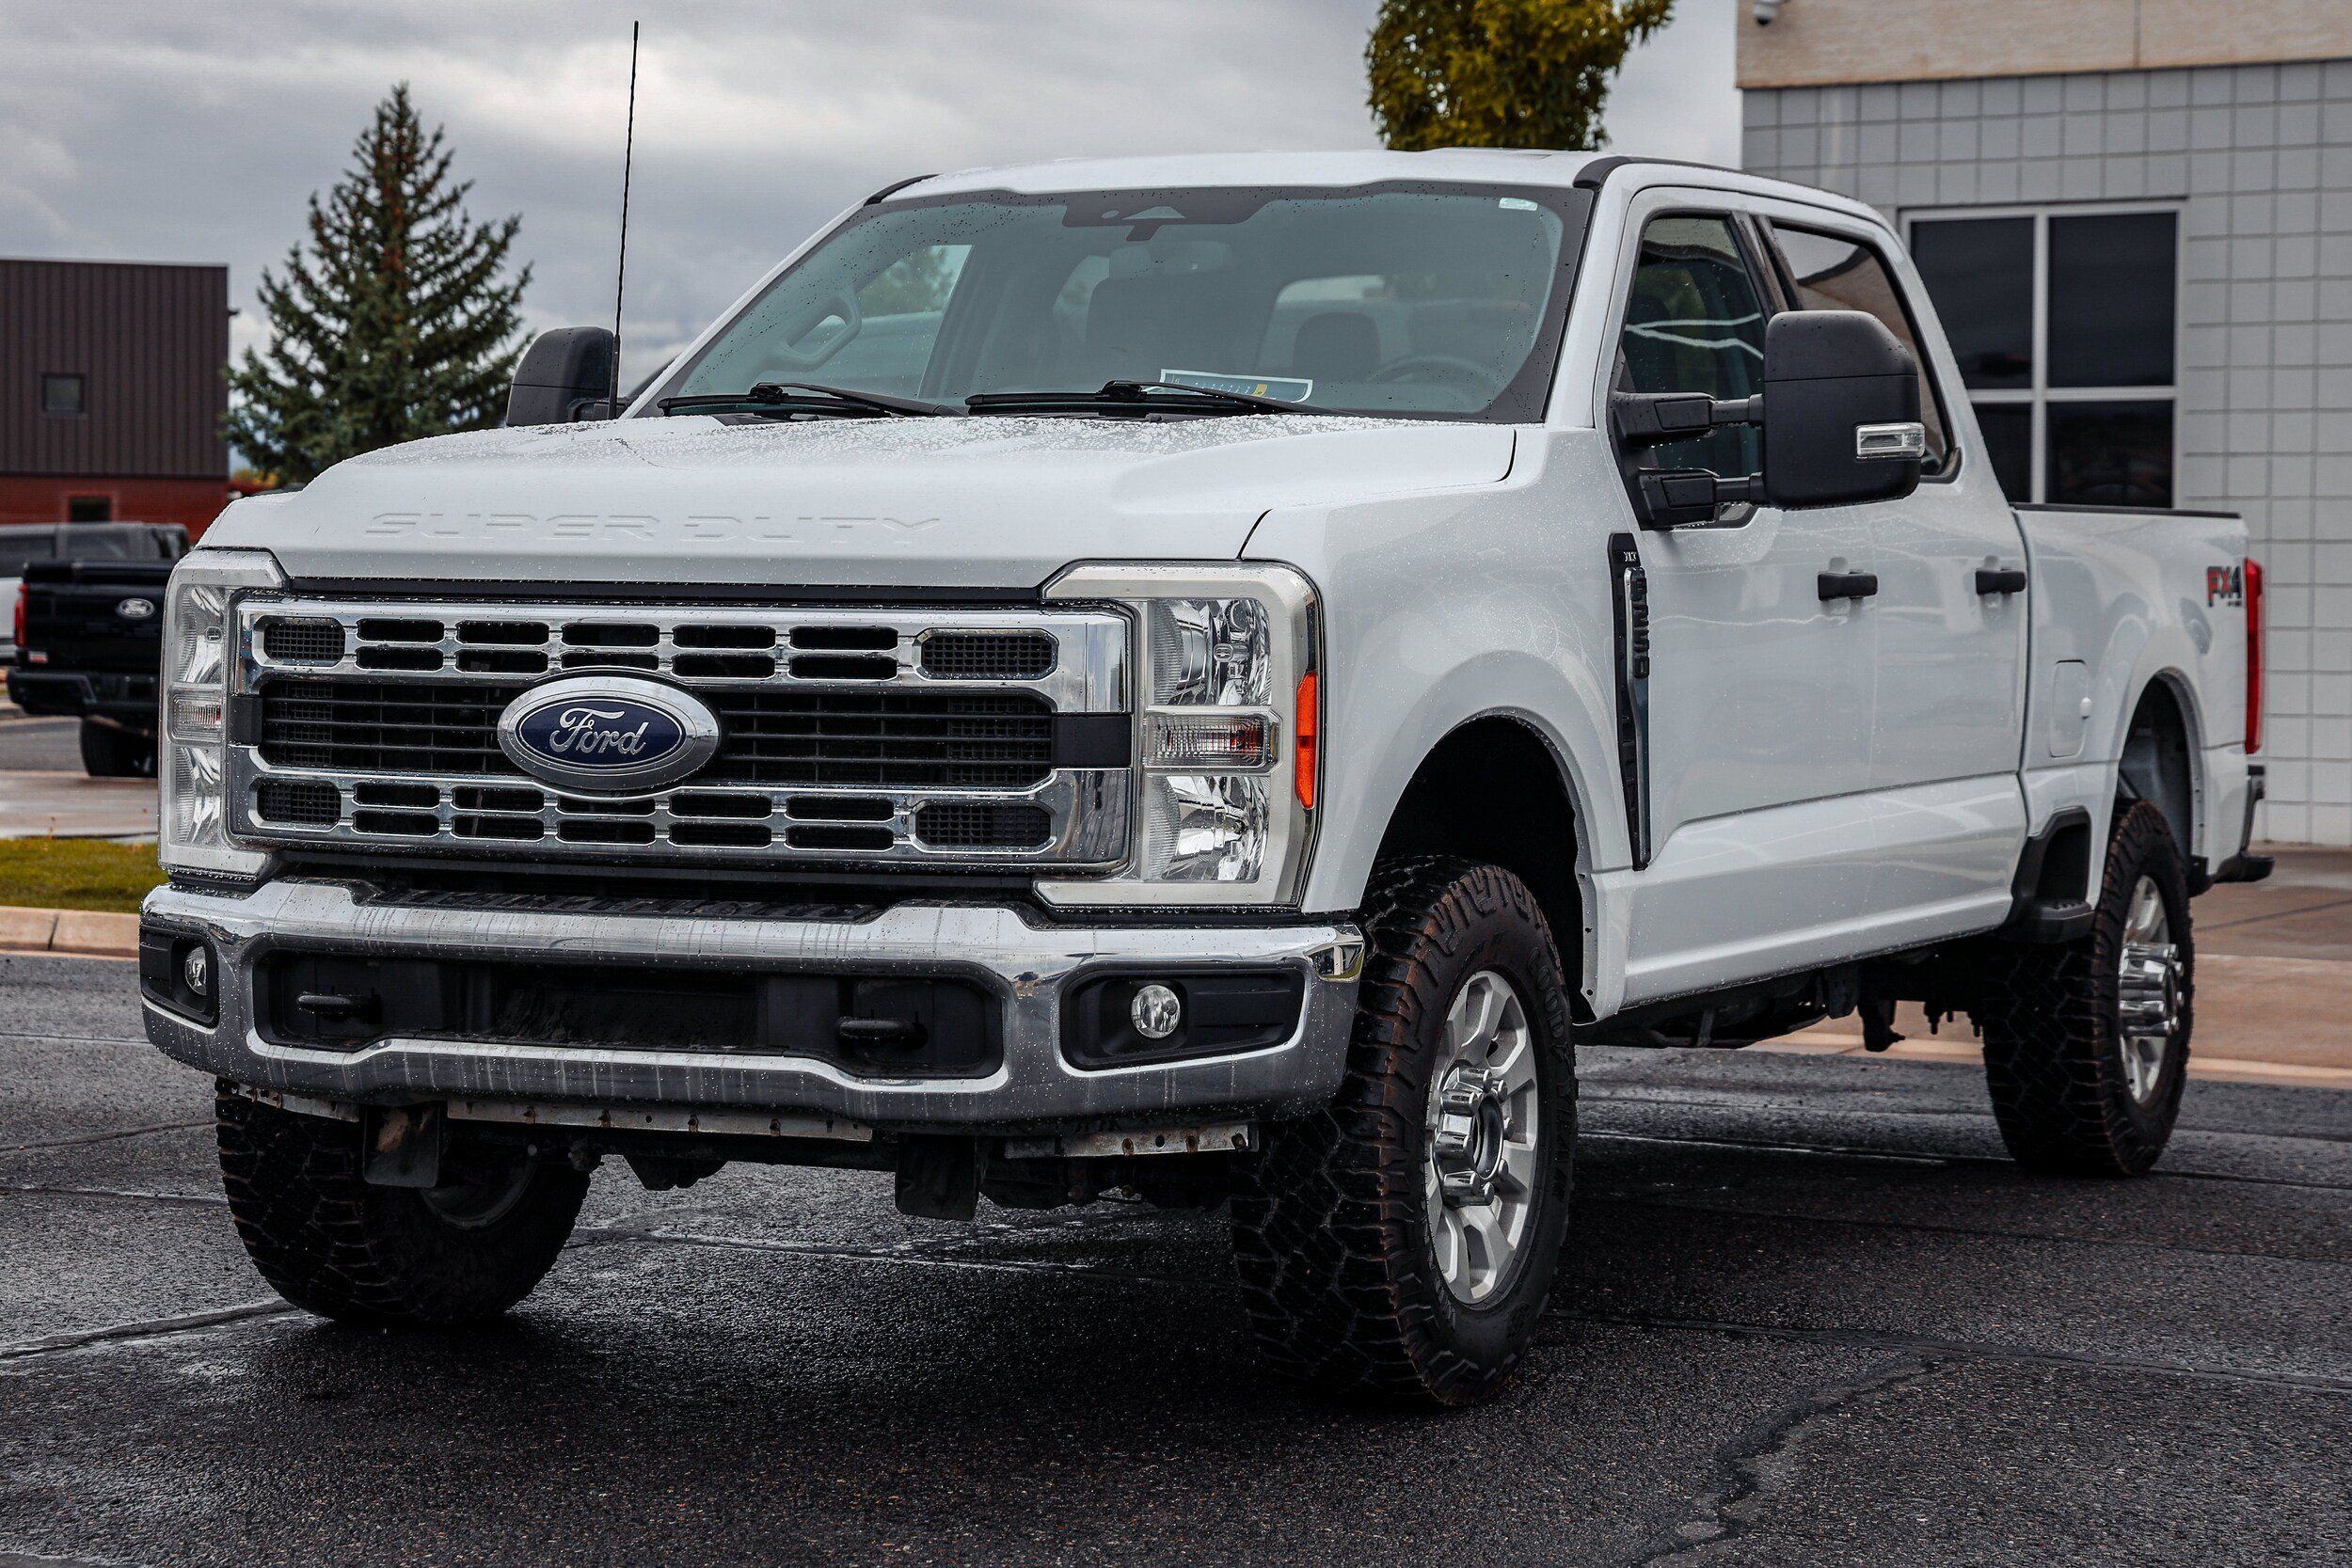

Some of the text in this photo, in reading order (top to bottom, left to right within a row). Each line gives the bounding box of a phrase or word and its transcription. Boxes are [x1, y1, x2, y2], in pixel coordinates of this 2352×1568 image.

[365, 512, 940, 544] SUPER DUTY
[2206, 565, 2241, 608] FX4
[548, 706, 649, 755] Ford
